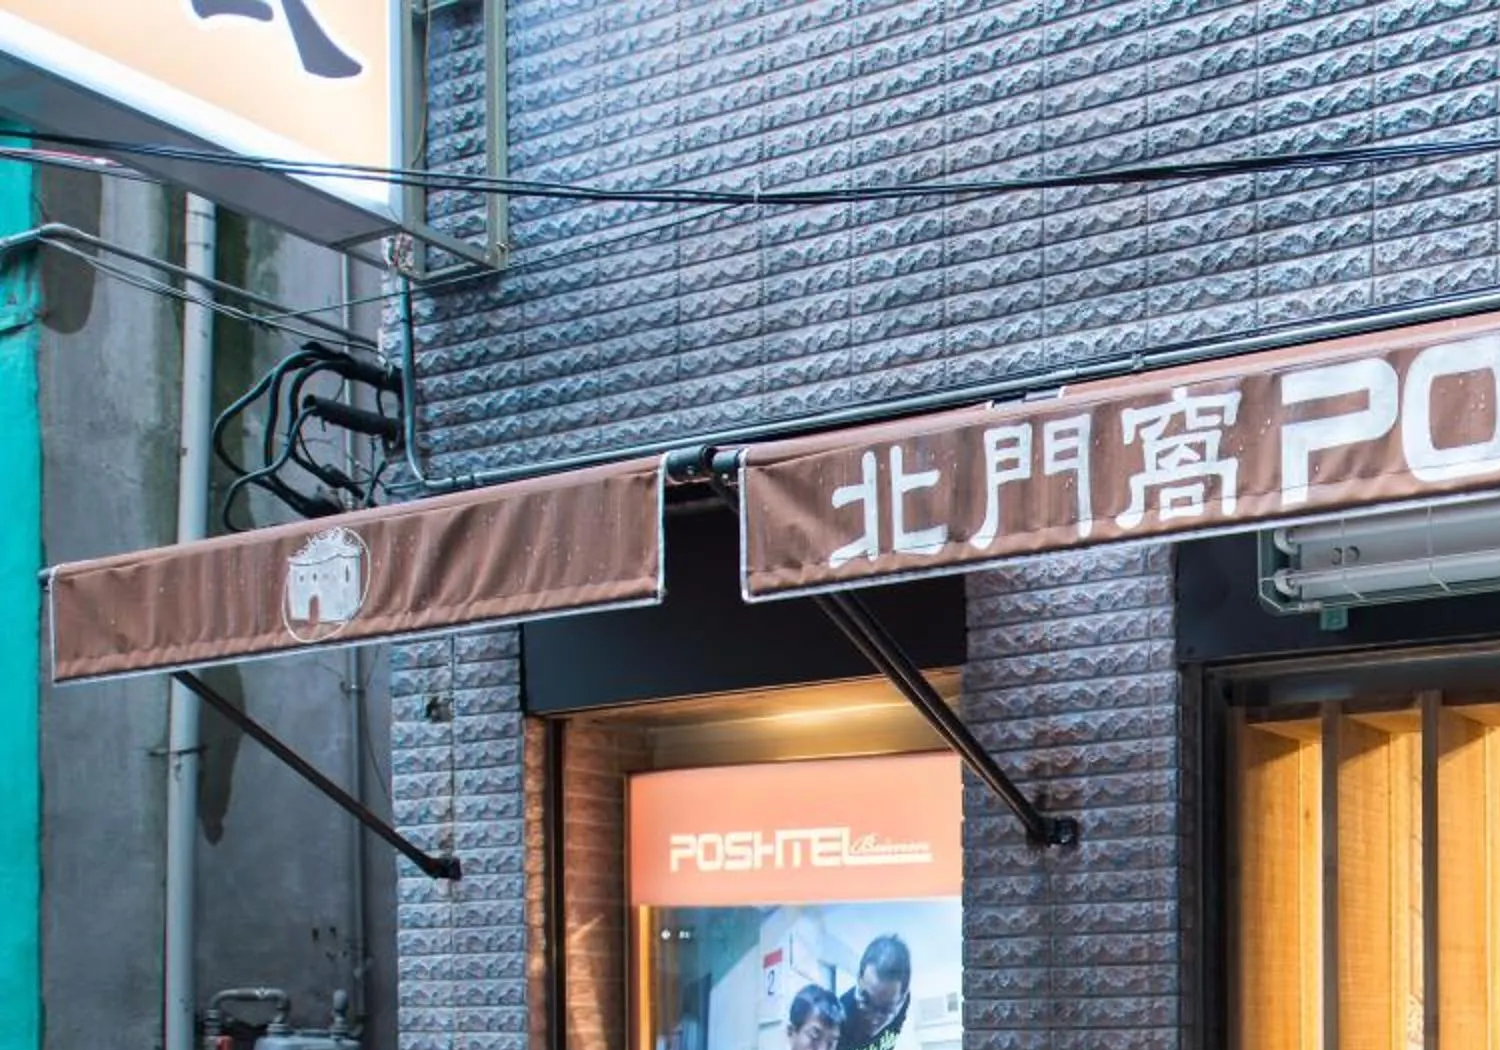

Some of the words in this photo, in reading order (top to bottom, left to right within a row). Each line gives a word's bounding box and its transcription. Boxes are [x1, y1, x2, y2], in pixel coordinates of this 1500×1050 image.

[829, 387, 1242, 568] 北門窩
[670, 827, 932, 872] POSHTEL
